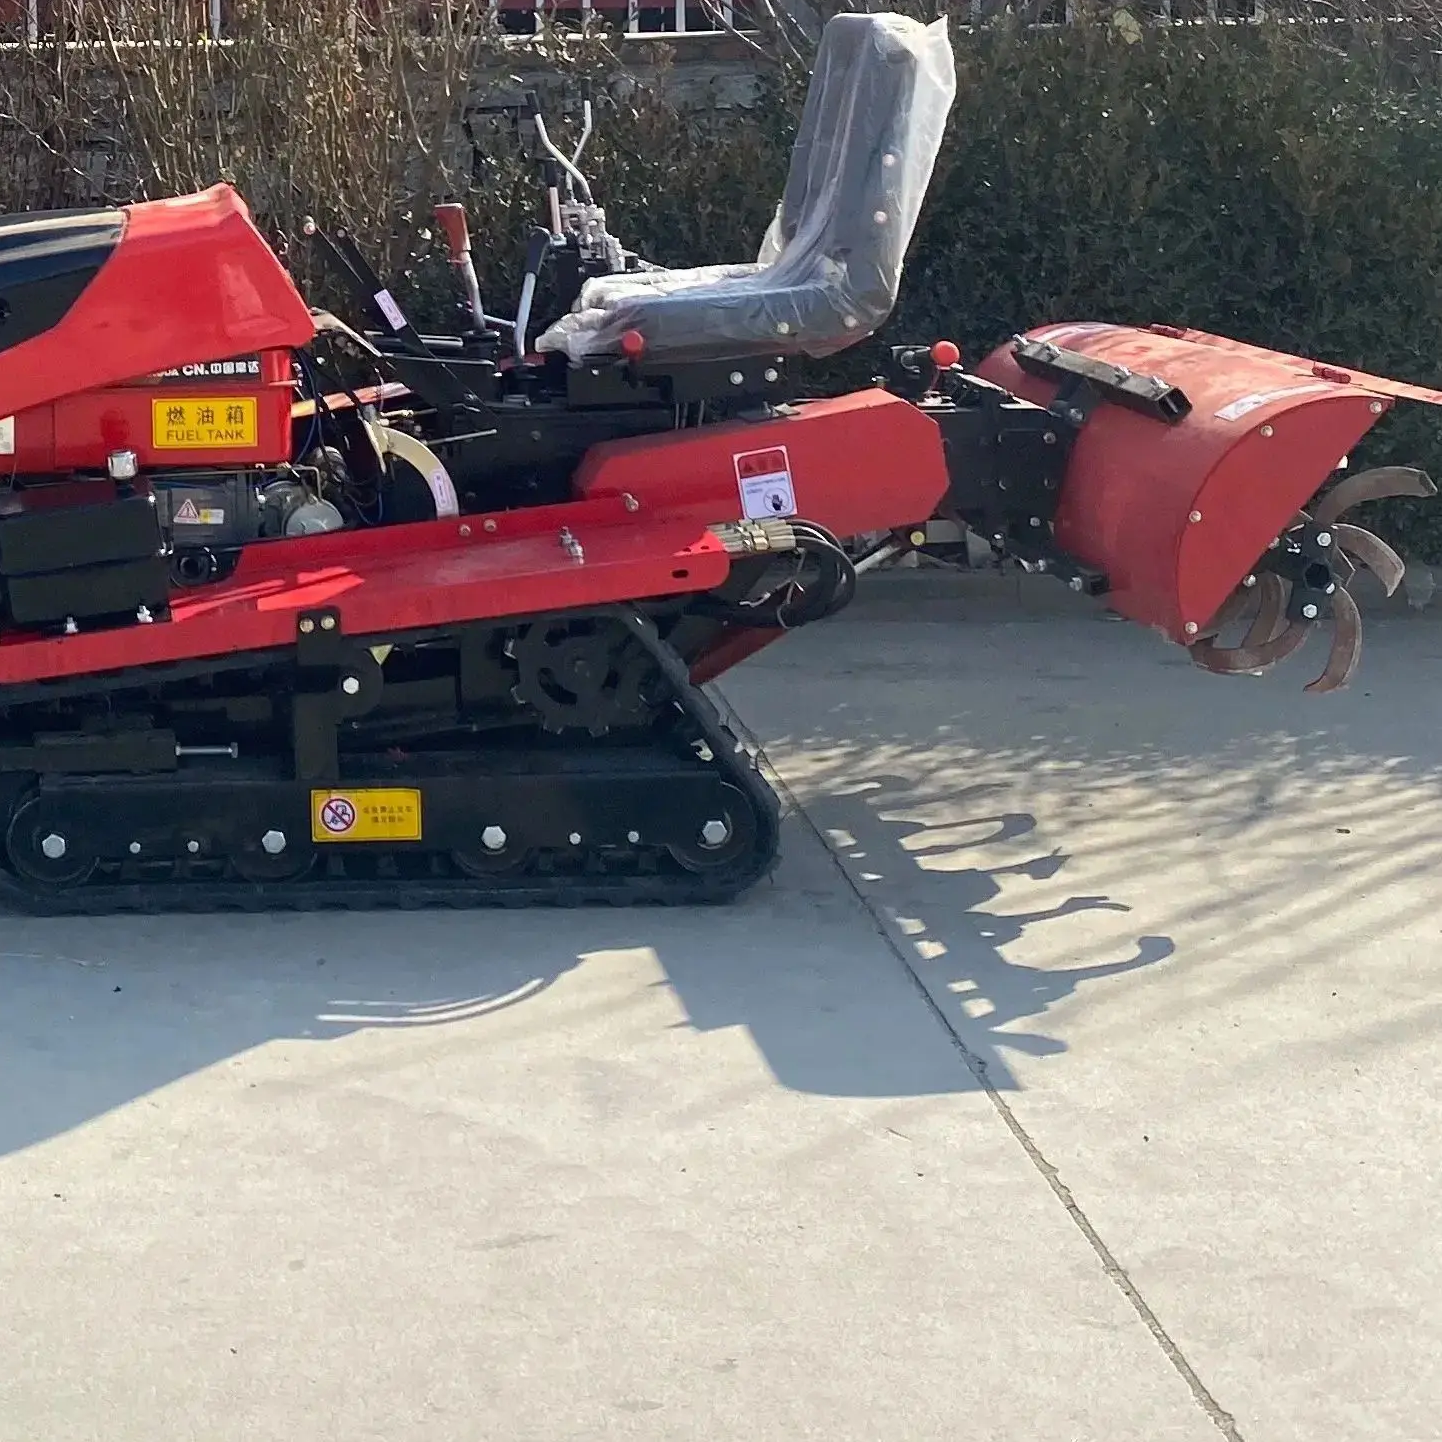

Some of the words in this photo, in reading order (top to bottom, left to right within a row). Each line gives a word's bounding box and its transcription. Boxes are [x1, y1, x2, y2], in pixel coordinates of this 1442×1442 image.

[166, 405, 244, 426] 燃油箱
[166, 429, 204, 442] FUEL
[208, 429, 246, 441] TANK
